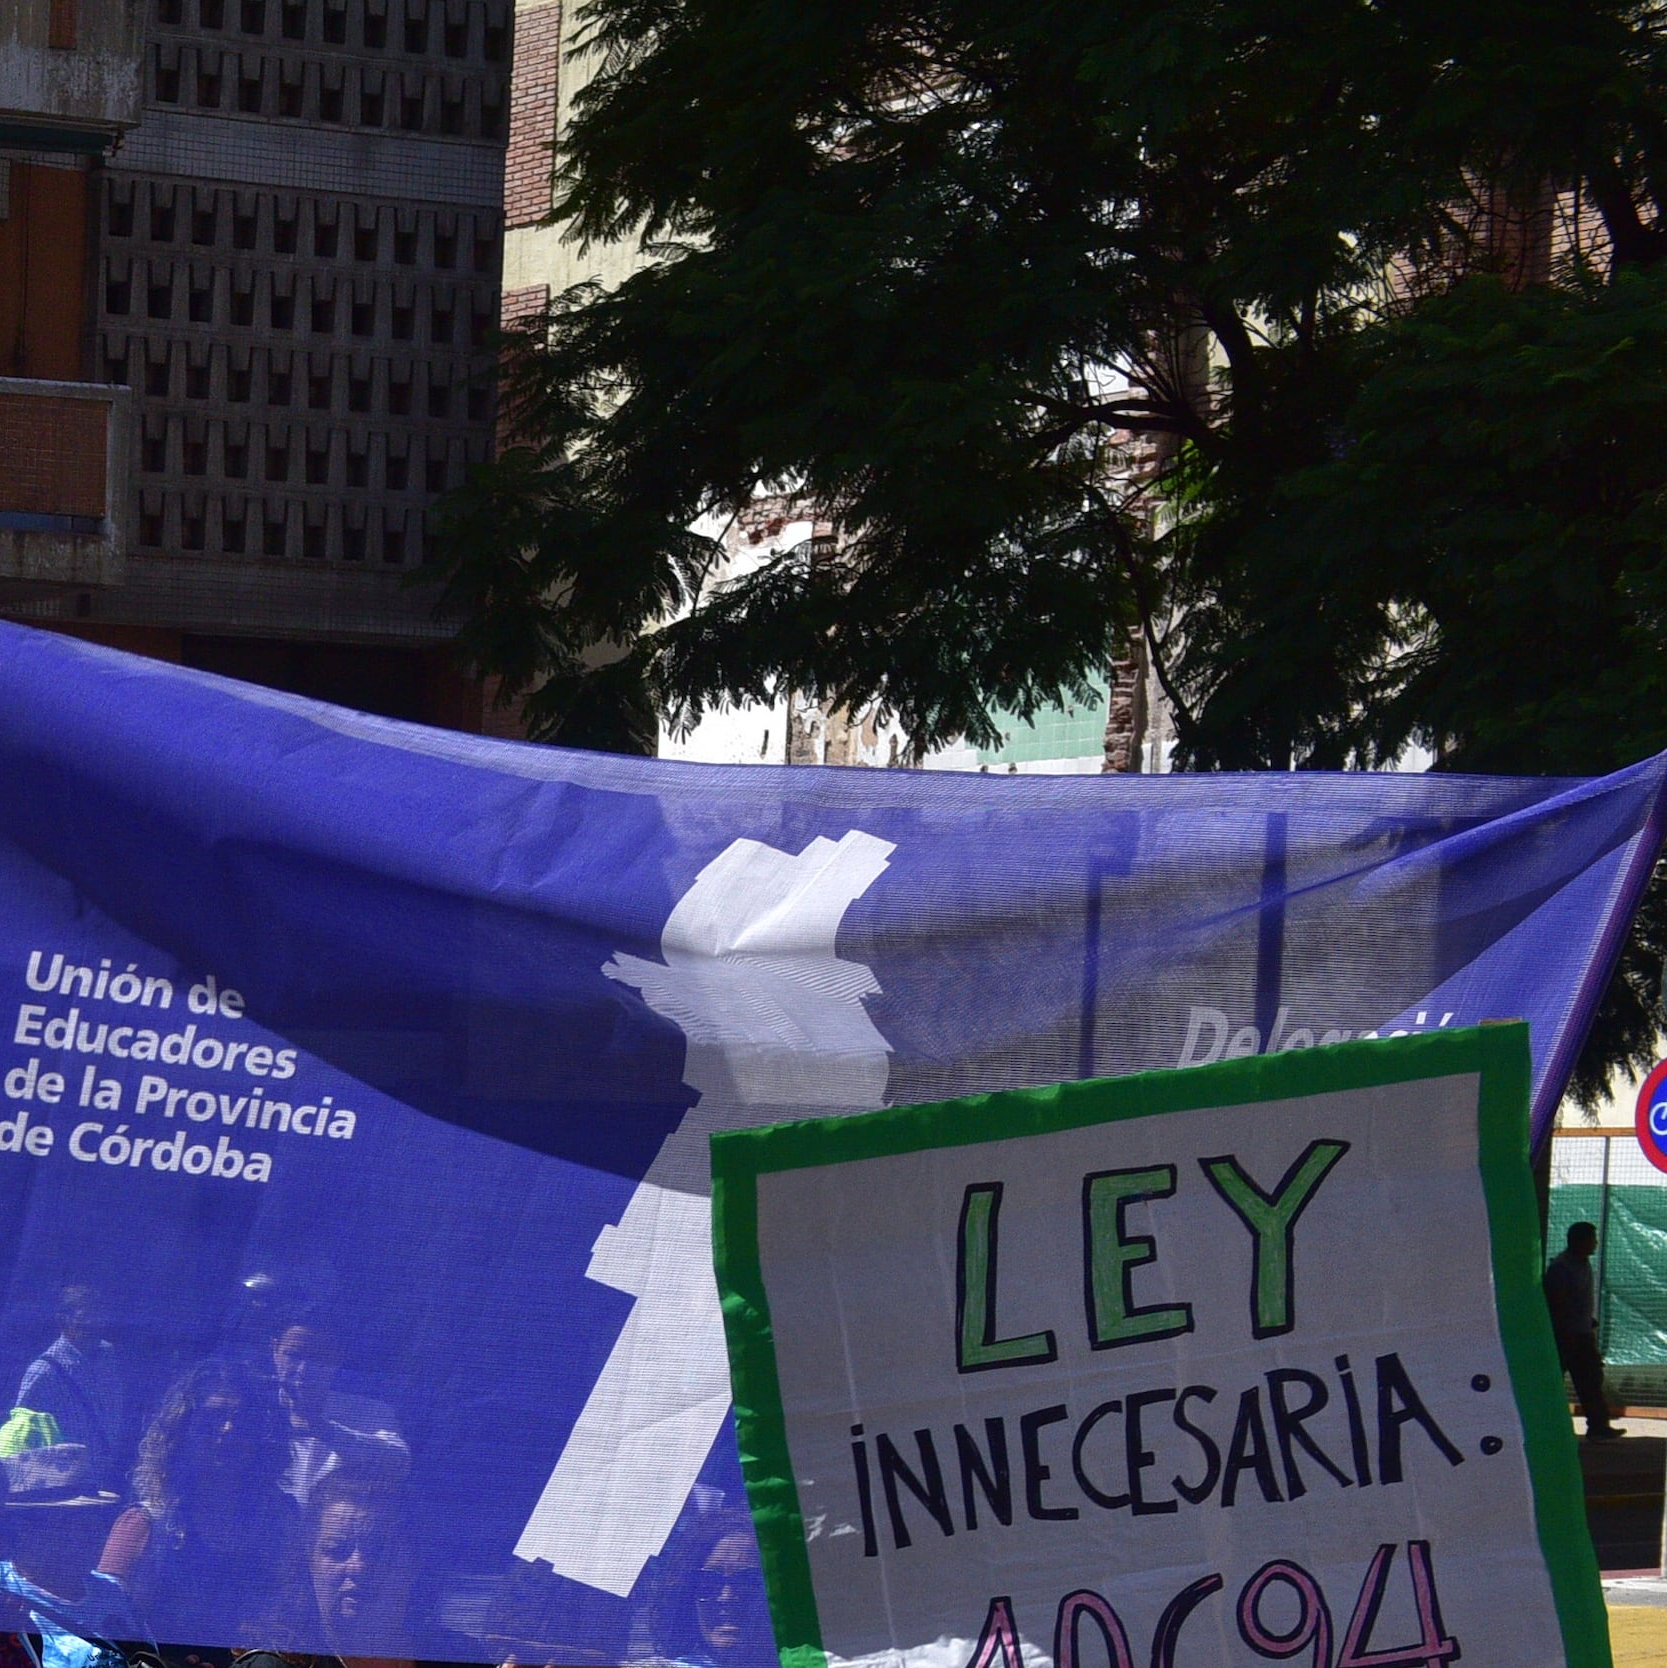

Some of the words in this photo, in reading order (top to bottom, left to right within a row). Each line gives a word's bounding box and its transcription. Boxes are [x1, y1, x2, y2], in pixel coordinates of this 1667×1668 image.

[24, 949, 173, 1010] Unión
[186, 975, 248, 1019] de
[11, 1004, 299, 1080] Educadores
[3, 1057, 63, 1106] de
[77, 1065, 123, 1113] la
[135, 1078, 359, 1141] Provincia
[66, 1119, 274, 1183] Córdoba
[954, 1138, 1350, 1375] LEY
